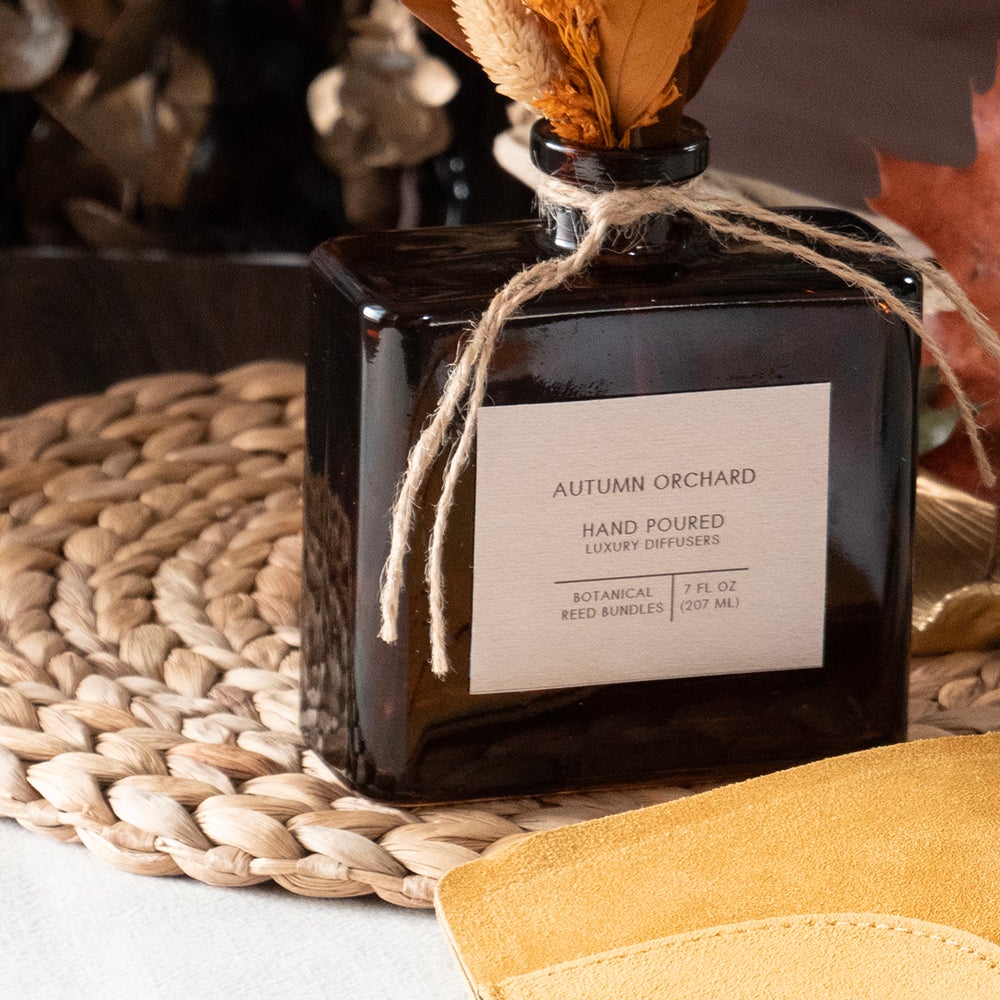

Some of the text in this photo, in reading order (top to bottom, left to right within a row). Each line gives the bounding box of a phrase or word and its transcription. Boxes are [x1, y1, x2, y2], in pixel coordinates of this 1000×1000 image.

[552, 468, 756, 498] AUTUMN ORCHARD
[582, 513, 725, 538] HAND POURED
[585, 534, 721, 555] LUXURY DIFFUSERS
[573, 586, 654, 603] BOTANICAL
[683, 580, 737, 594] 7 FL OZ
[561, 602, 665, 621] REED BUNDLES
[680, 596, 740, 613] (207 ML)
